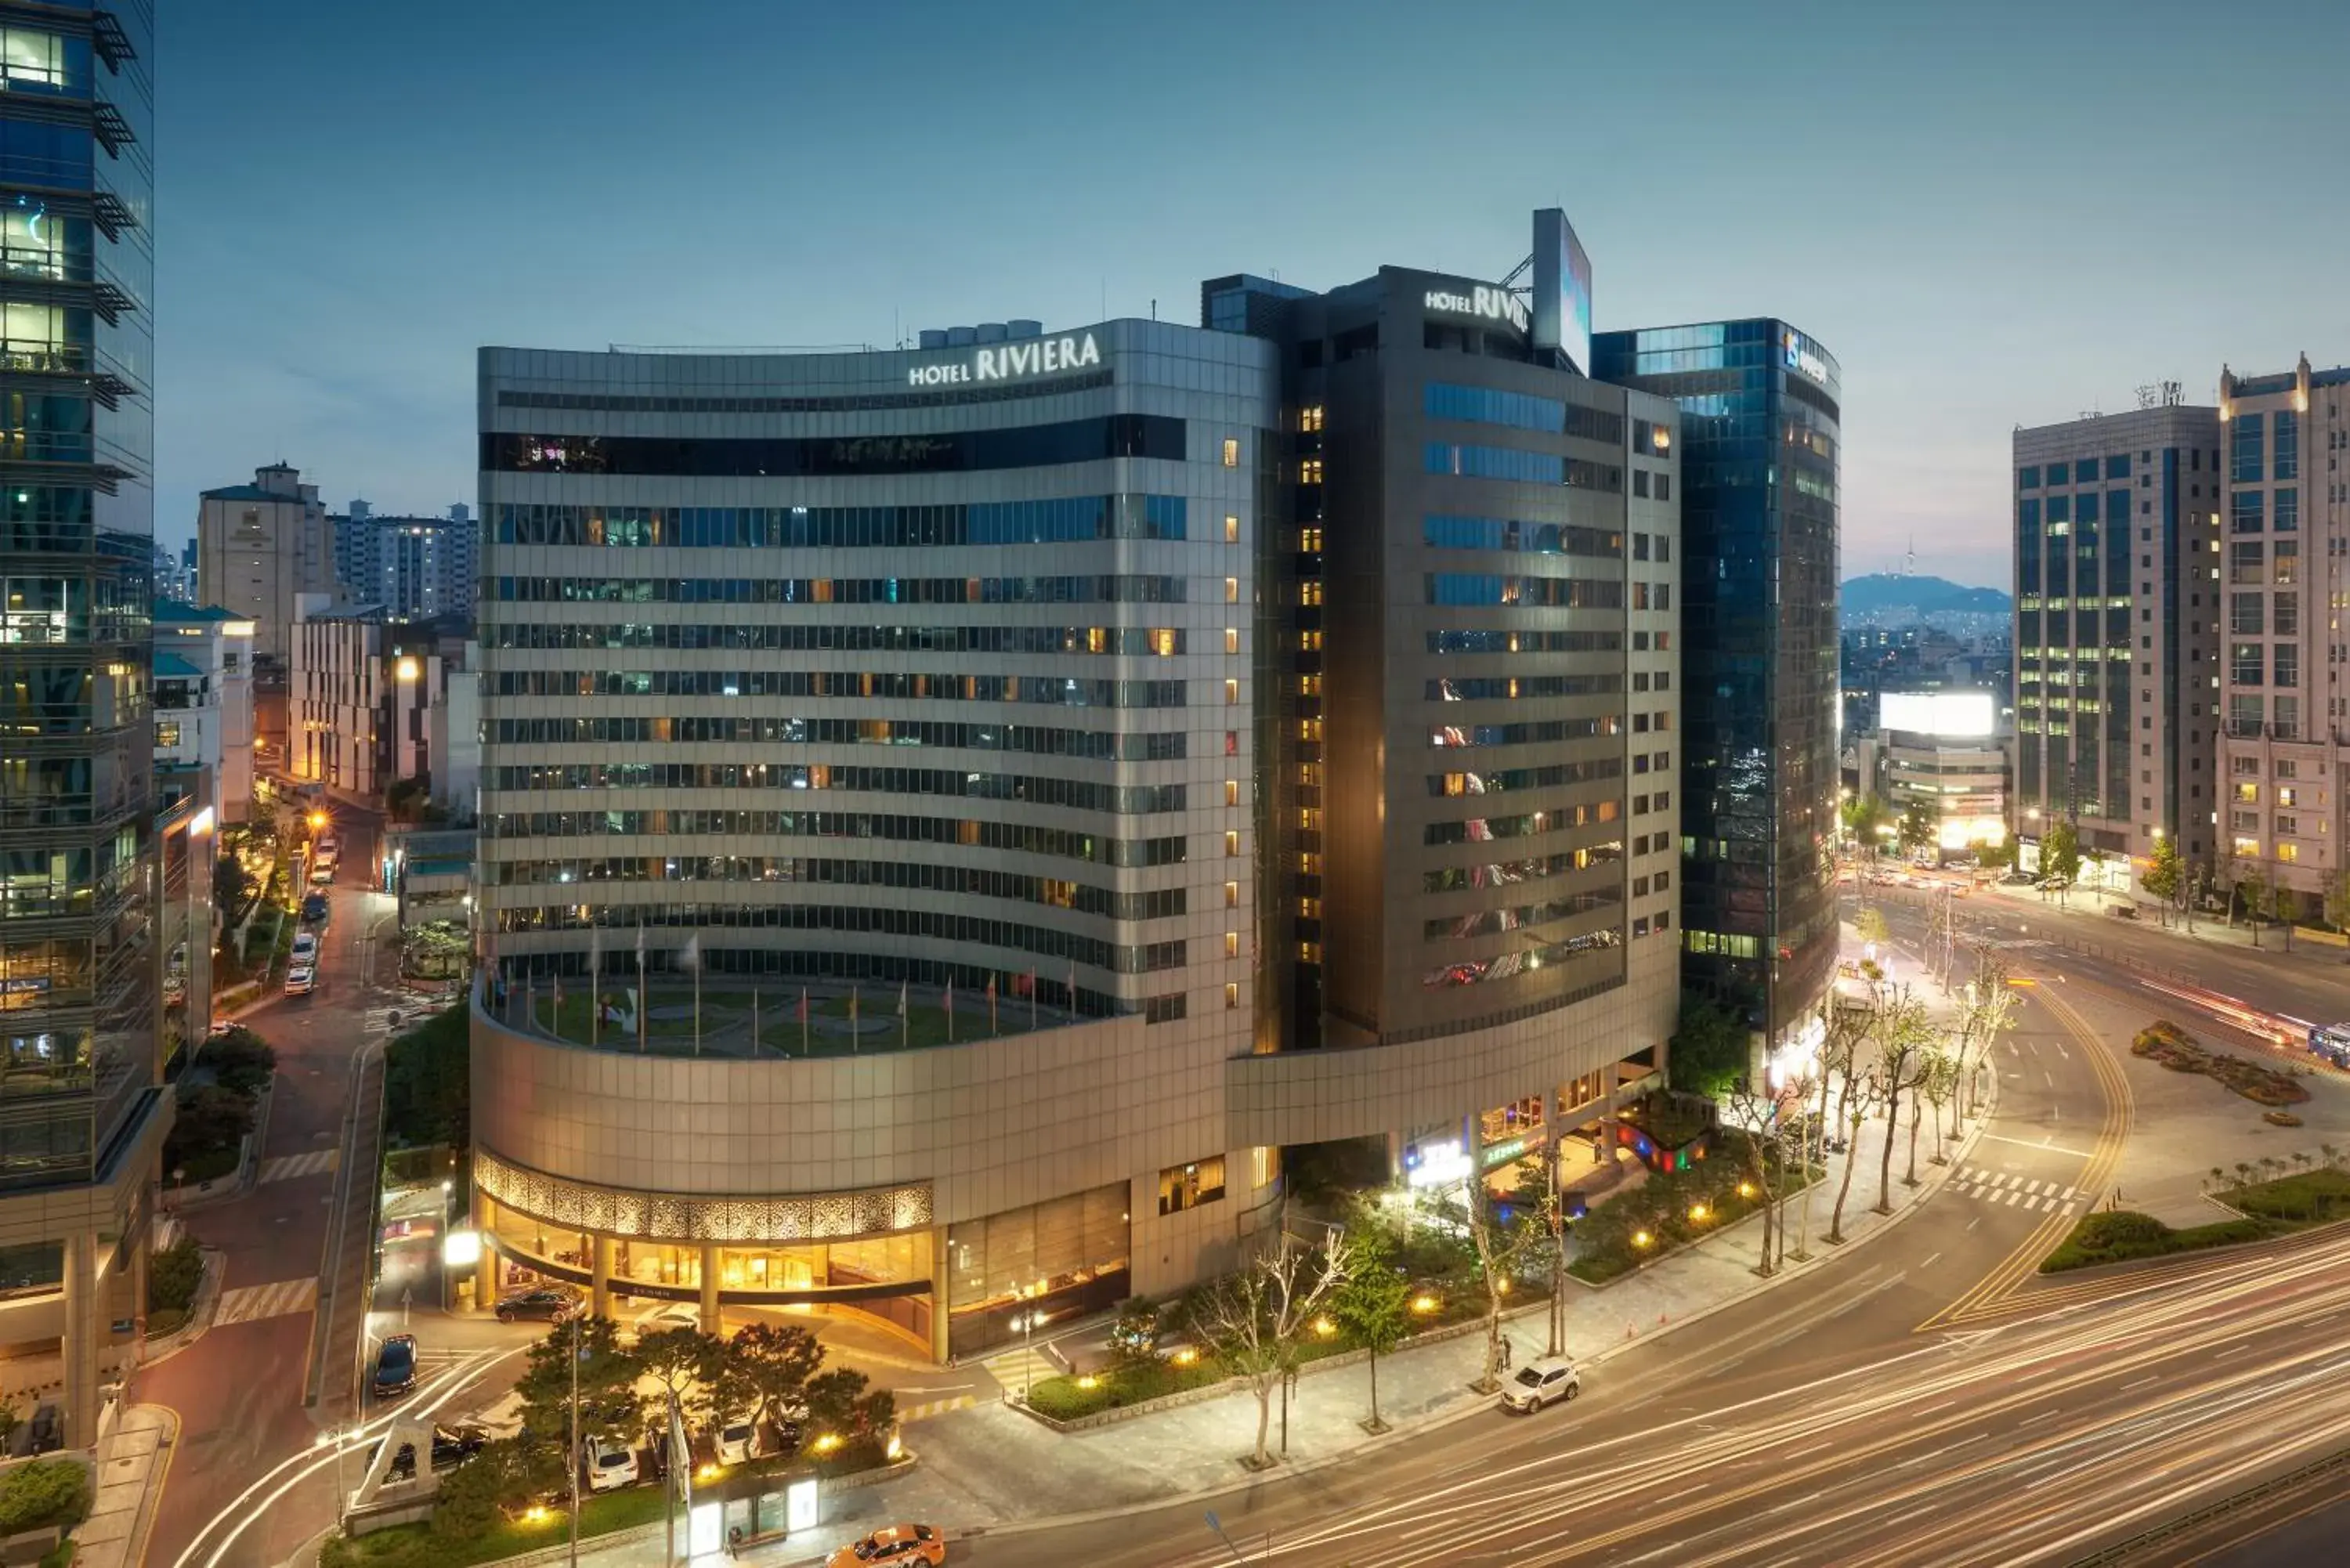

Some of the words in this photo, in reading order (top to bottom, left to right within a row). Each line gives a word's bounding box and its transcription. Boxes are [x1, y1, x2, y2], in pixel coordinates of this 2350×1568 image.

[1425, 291, 1473, 313] HOTEL
[909, 363, 971, 386] HOTEL
[977, 333, 1101, 381] RIVIERA
